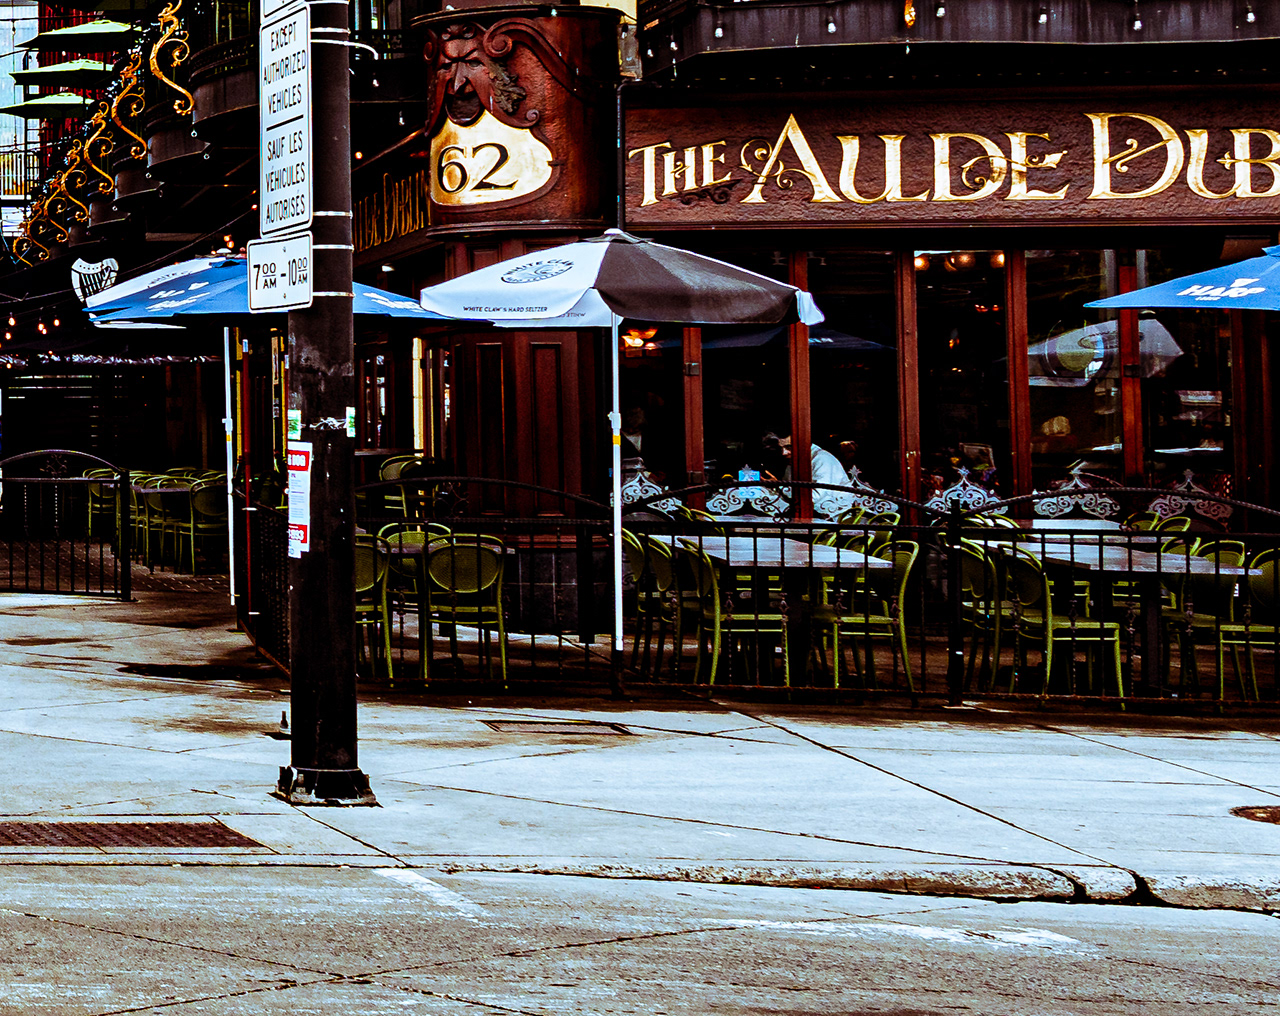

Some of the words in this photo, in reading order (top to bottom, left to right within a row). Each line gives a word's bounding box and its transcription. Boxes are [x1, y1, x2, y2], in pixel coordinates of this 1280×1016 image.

[270, 20, 297, 52] EXCEPT
[263, 49, 307, 87] AUTHORIZED
[267, 83, 302, 115] VEHICLES
[267, 136, 285, 162] SAUF
[289, 130, 303, 154] LES
[265, 161, 306, 193] VÉHICULES
[437, 142, 519, 194] 62
[628, 139, 733, 207] THE
[263, 278, 277, 290] AM
[1176, 284, 1267, 298] HARP
